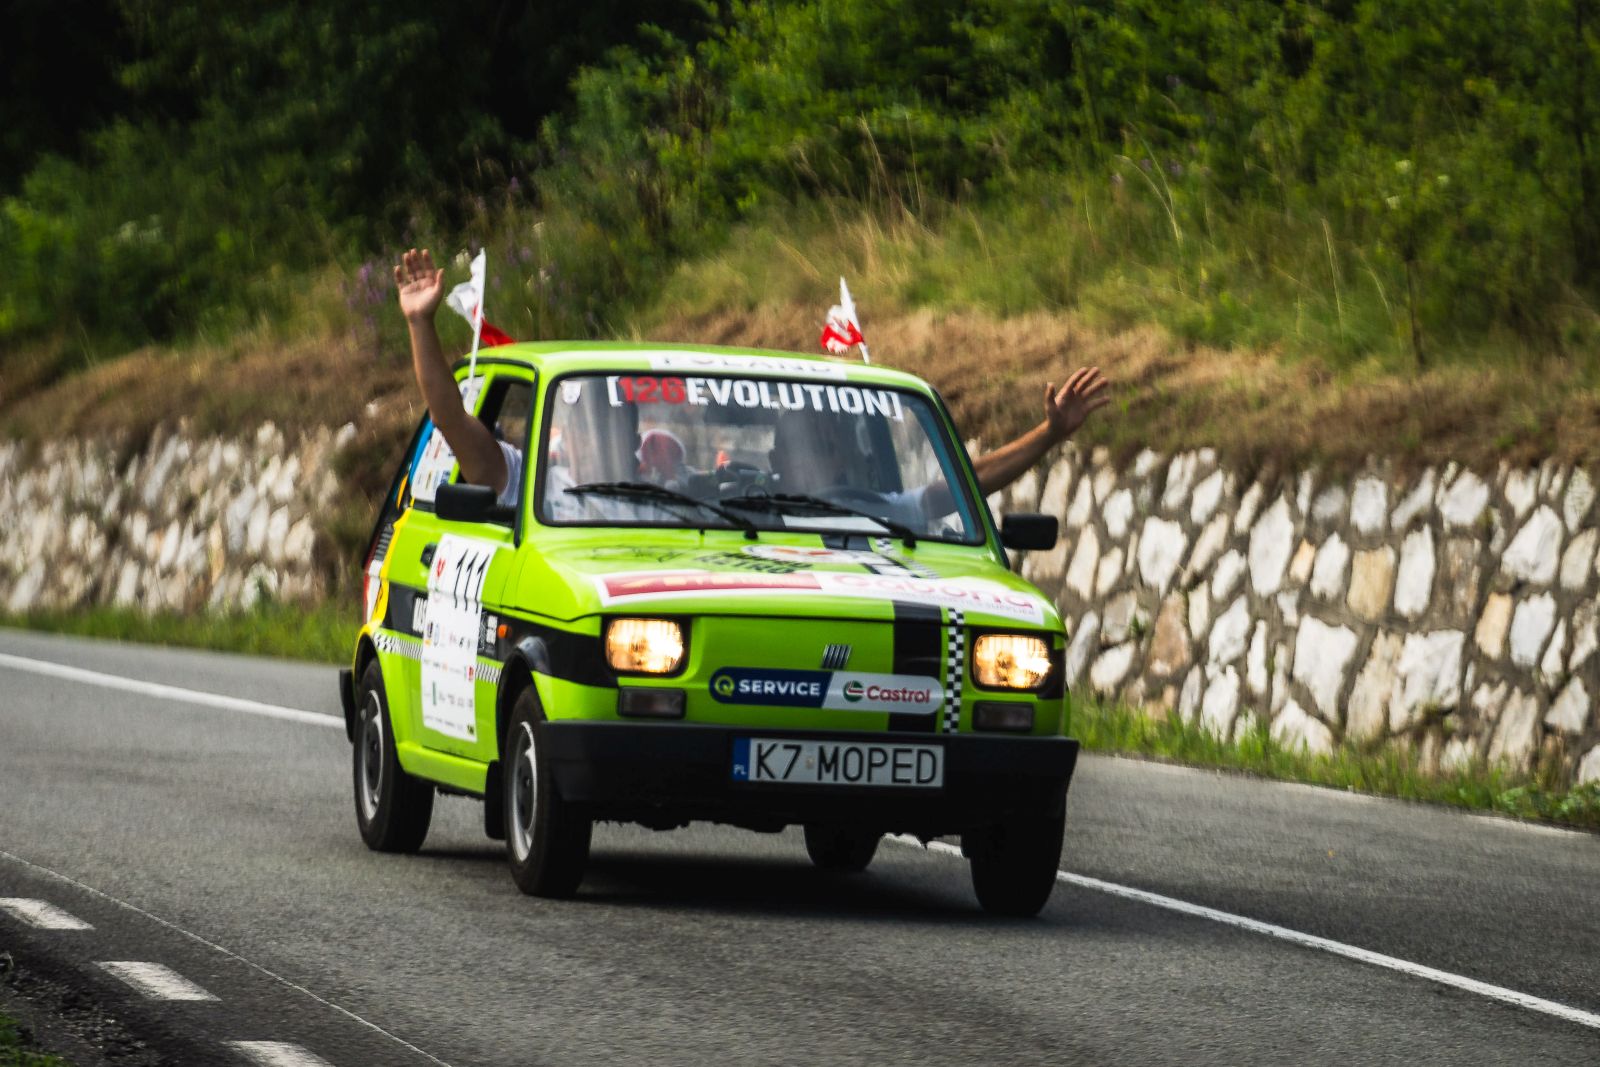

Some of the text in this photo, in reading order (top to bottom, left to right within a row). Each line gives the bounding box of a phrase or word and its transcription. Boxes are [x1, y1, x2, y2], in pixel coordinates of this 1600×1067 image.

[453, 548, 490, 615] 111
[738, 678, 822, 697] SERVICE
[866, 685, 931, 704] Castrol
[733, 764, 748, 776] PL
[756, 742, 937, 784] K7 MOPED
